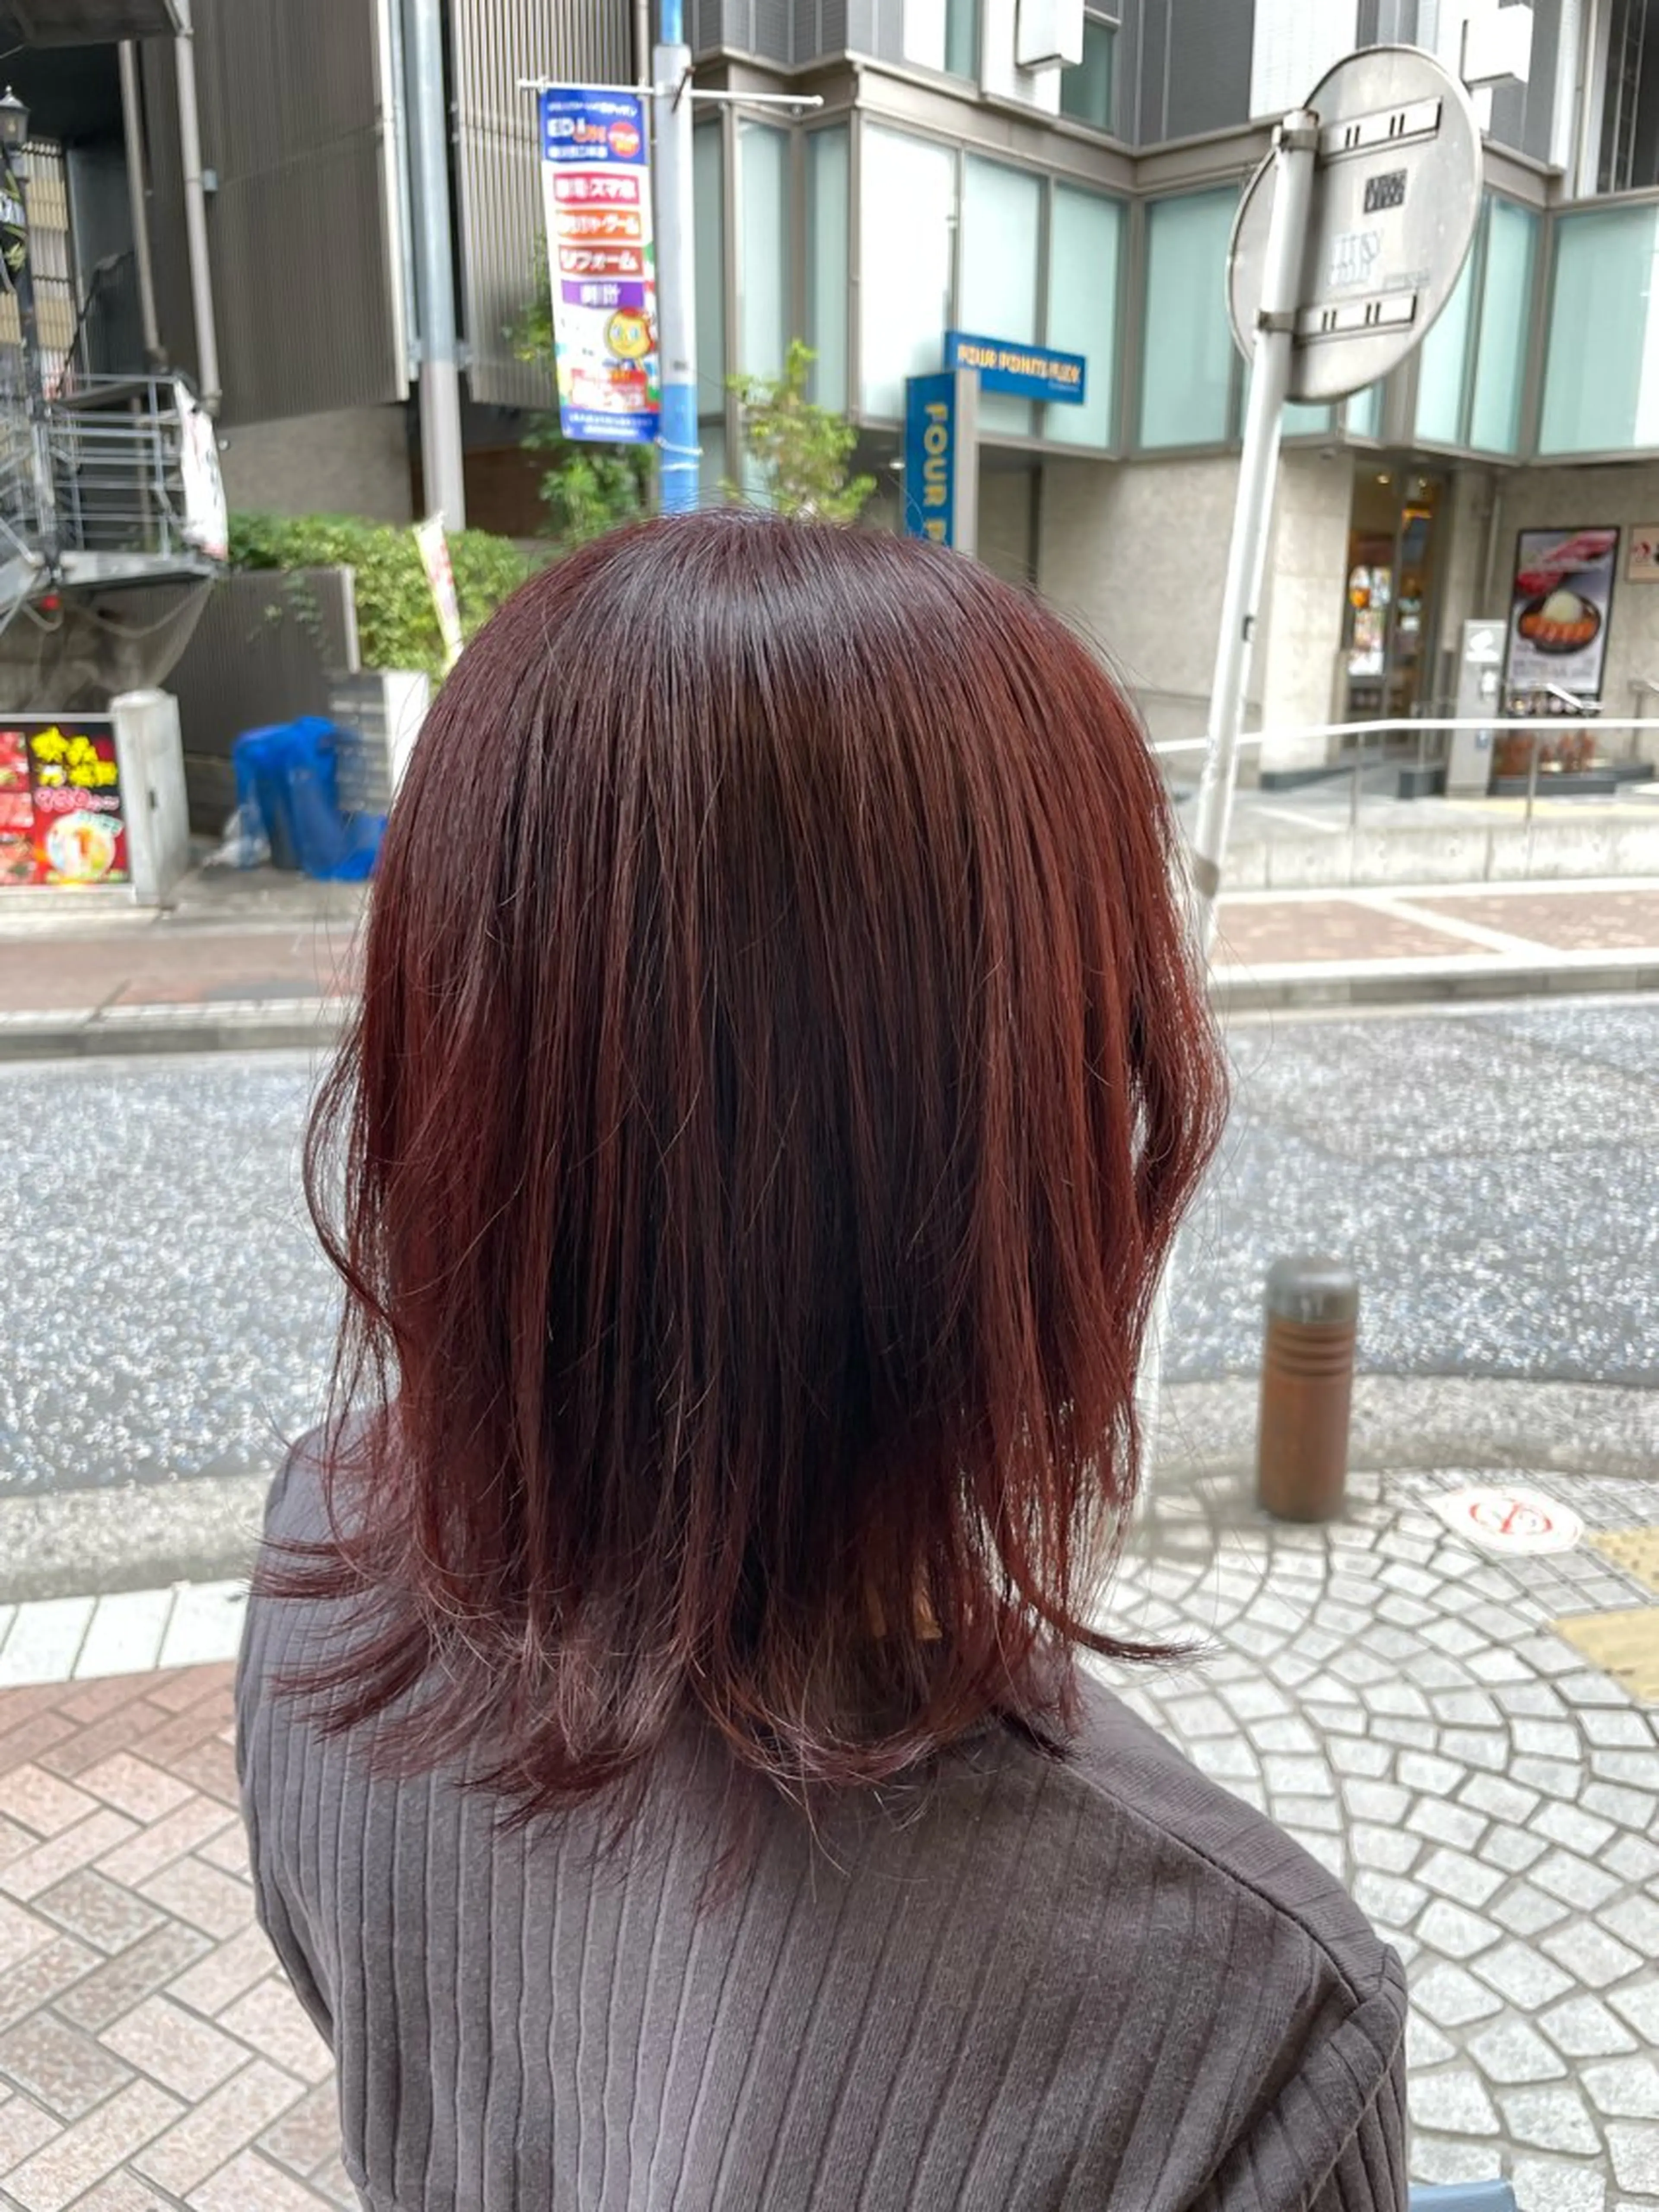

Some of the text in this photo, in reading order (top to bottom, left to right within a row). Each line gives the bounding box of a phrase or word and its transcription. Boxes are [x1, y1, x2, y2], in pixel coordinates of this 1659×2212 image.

[560, 248, 638, 271] リフォーム
[957, 343, 997, 368] FOUR
[923, 403, 948, 507] FOUR
